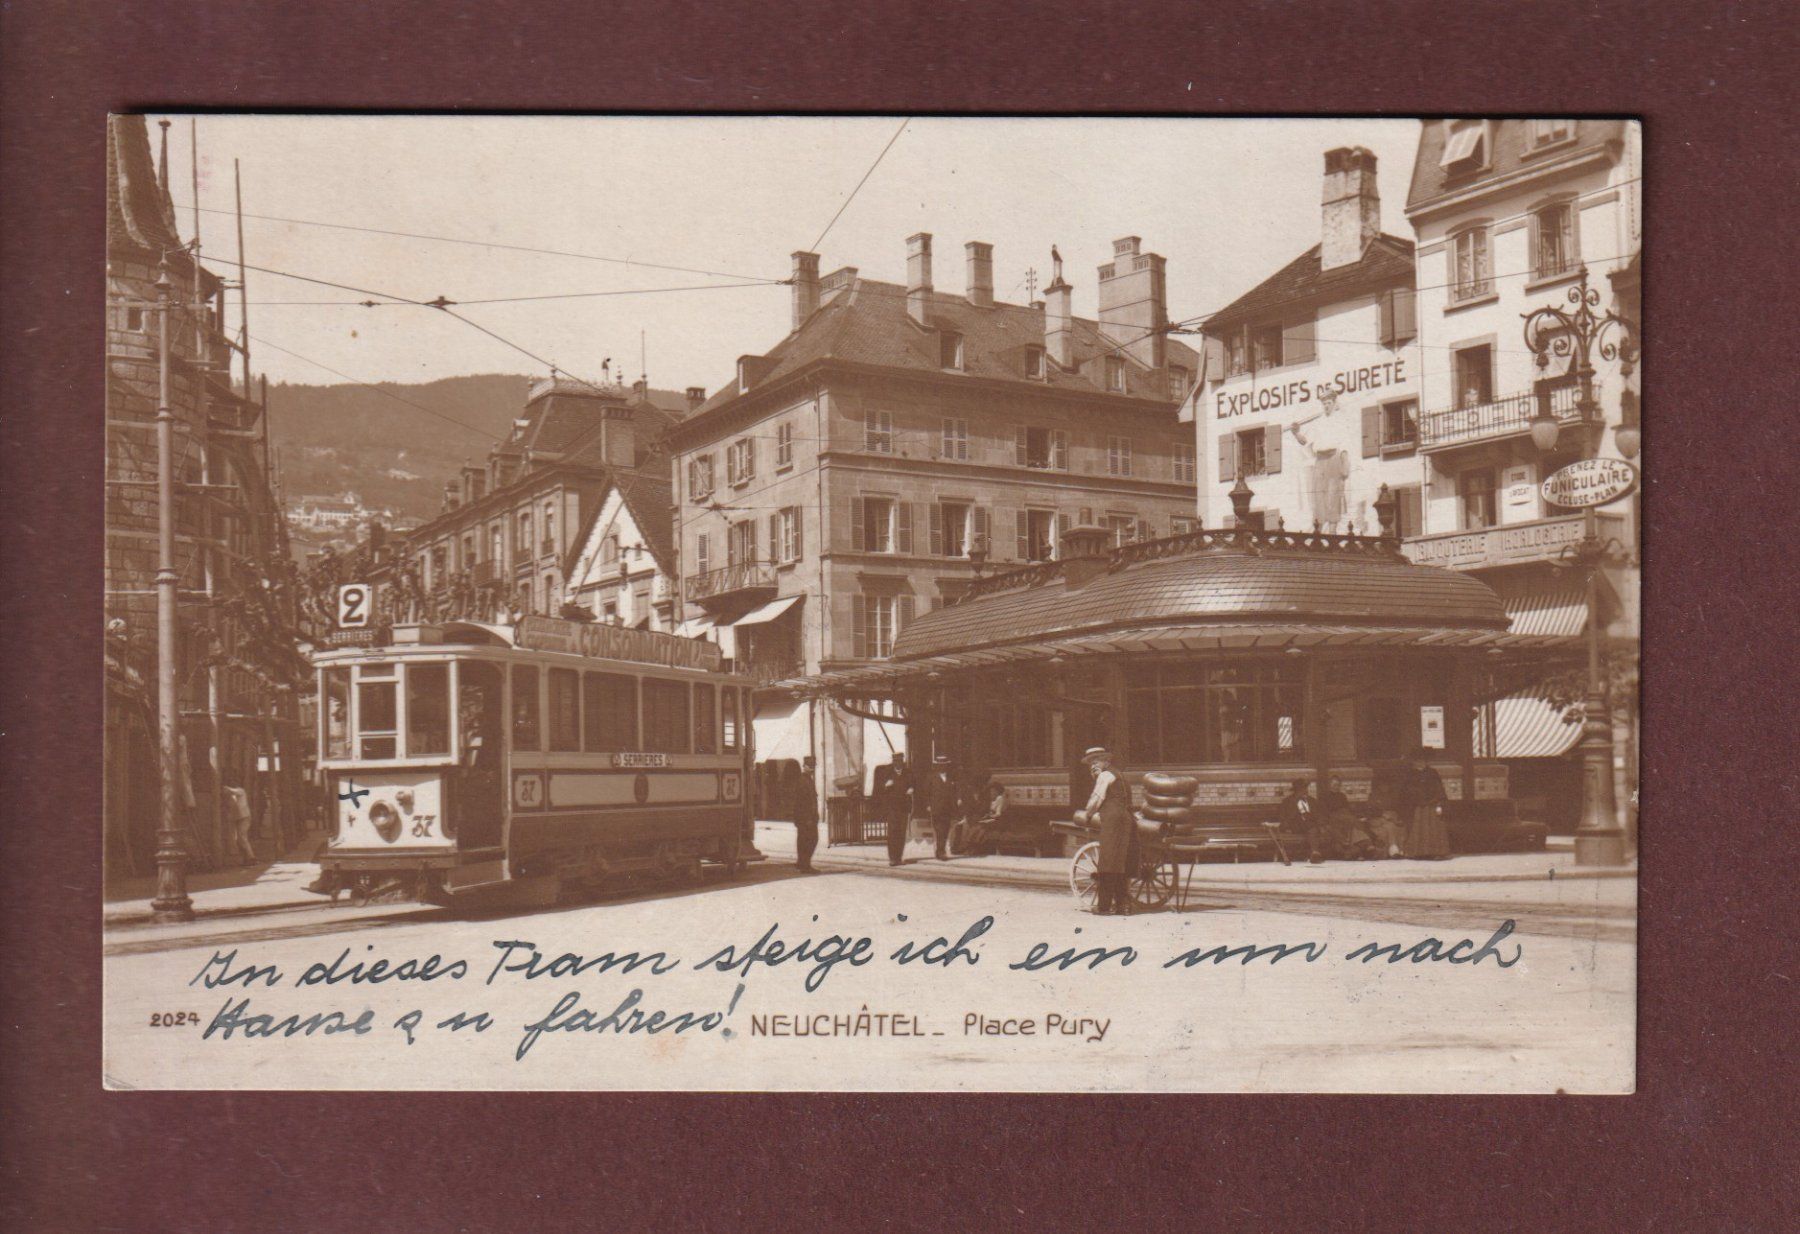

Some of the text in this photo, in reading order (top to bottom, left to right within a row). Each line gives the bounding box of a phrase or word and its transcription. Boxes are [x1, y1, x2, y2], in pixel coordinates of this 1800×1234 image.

[1216, 380, 1311, 419] EXPLOSIFS
[1544, 468, 1630, 496] FUNICULAIRE
[1556, 460, 1616, 481] PRENEZ LE
[342, 588, 364, 624] 2
[411, 815, 437, 838] 37
[189, 949, 283, 990] In
[295, 944, 468, 988] dieses
[486, 939, 680, 985] Tram
[693, 914, 874, 992] steige
[889, 914, 994, 967] ich
[1008, 928, 1138, 971] ein
[1344, 919, 1522, 969] nach
